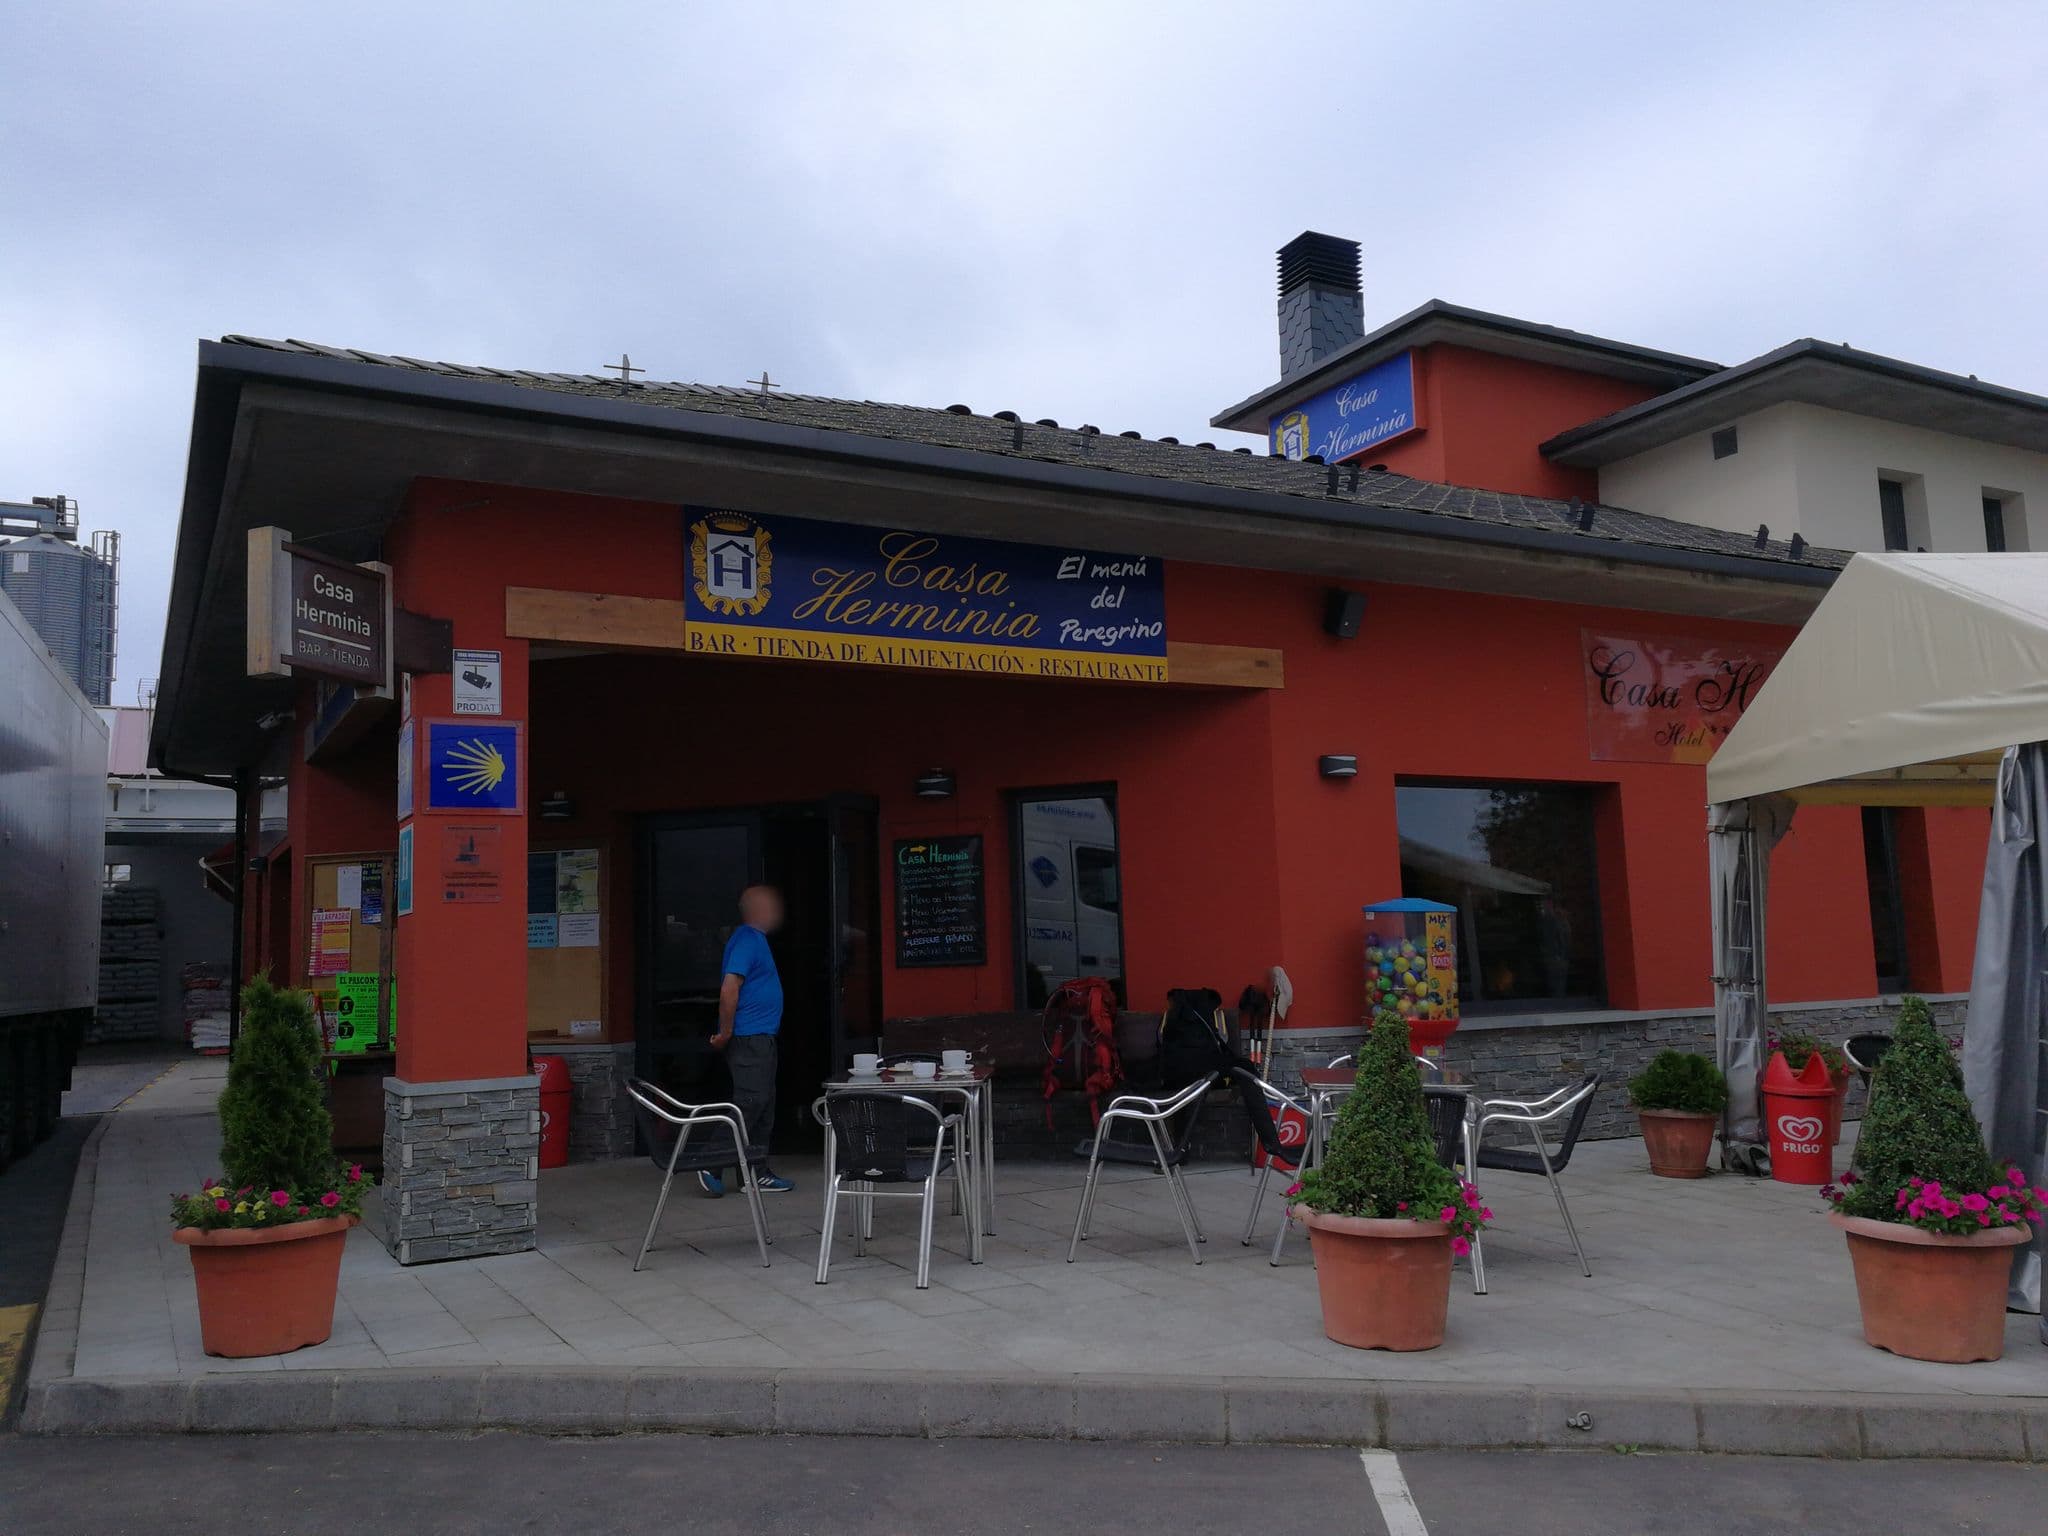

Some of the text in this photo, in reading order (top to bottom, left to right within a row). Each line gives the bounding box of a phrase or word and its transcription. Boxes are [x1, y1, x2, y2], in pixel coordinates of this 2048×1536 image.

[1336, 384, 1380, 417] Casa
[1314, 409, 1408, 460] Herminia
[880, 531, 1009, 596] Casa
[1057, 555, 1146, 580] El menú
[313, 573, 354, 603] Casa
[793, 568, 1041, 638] Herminia
[1090, 585, 1126, 609] del
[296, 598, 371, 637] Herminia
[1059, 617, 1163, 647] Peregrino
[299, 641, 370, 669] BAR TIENDA
[690, 631, 1167, 682] BAR TIENDA DE ALIMENTACIÓN RESTAURANTE
[1590, 646, 1680, 709] Casa
[456, 702, 496, 712] PRODAT
[1655, 722, 1706, 746] Hotel
[1782, 1142, 1820, 1154] FRIGO
